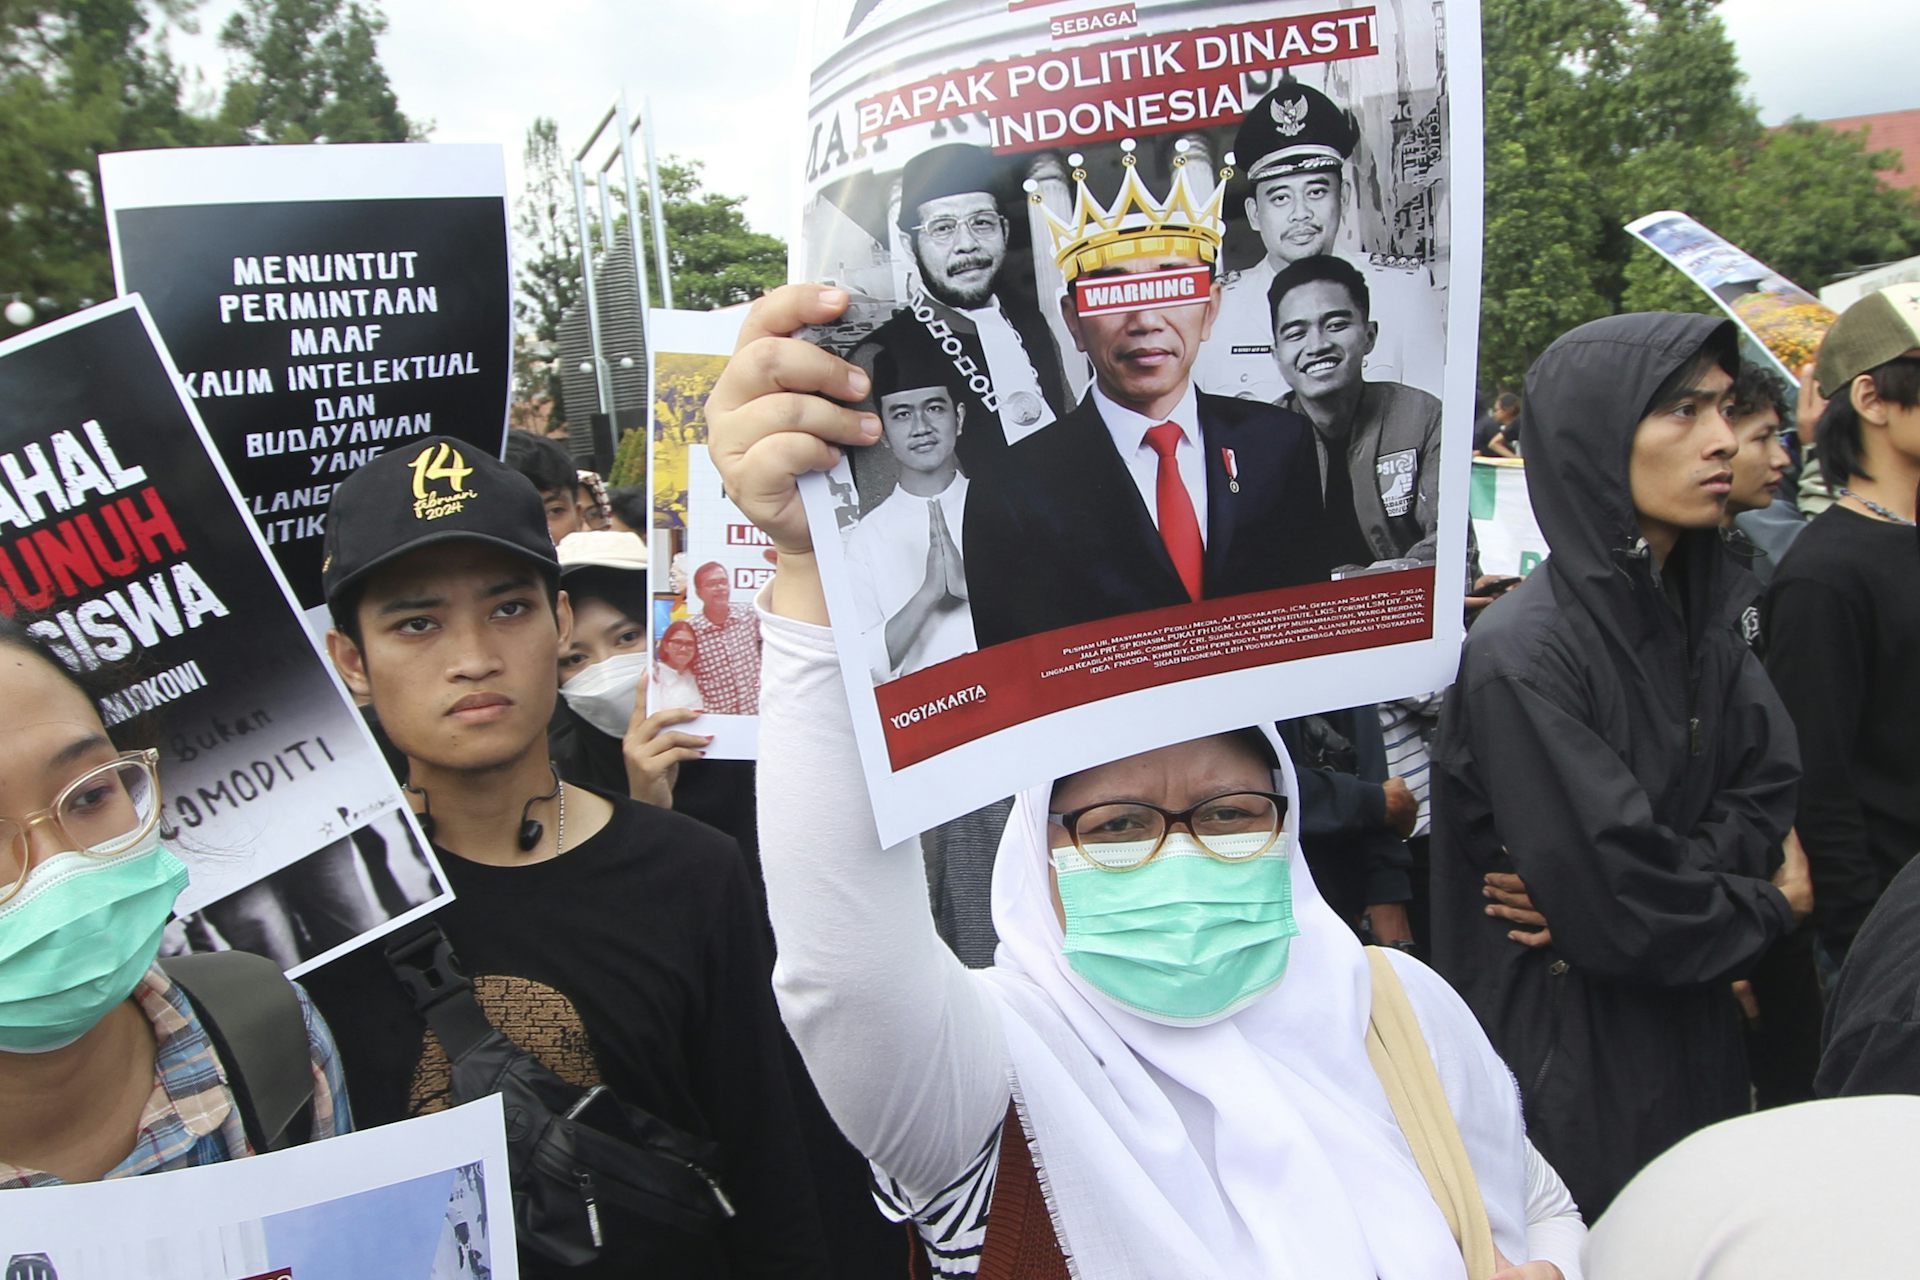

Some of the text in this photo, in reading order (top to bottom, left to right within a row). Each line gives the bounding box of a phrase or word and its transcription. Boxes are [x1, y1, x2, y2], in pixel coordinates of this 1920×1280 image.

[1051, 9, 1135, 36] SEBAGAI
[859, 71, 997, 134] BAPAK
[1007, 40, 1185, 98] POLITIK
[1195, 14, 1379, 70] DINASTI
[990, 84, 1243, 147] INDONESIA
[234, 251, 418, 286] MENUNTUT
[219, 286, 438, 323] PERMINTAAN
[1085, 276, 1195, 307] WARNING
[291, 324, 382, 356] MAAF
[288, 352, 480, 391] INTELEKTUAL
[315, 394, 375, 421] DAN
[246, 413, 431, 457] BUDAYAWAN
[407, 442, 474, 500] 14
[242, 482, 343, 515] LANG
[425, 501, 464, 520] 2024
[0, 486, 188, 618] UNUH
[737, 569, 777, 589] DE
[1080, 651, 1099, 660] JALA
[1120, 642, 1132, 650] SP
[1168, 631, 1195, 641] PUKAT
[1235, 618, 1271, 628] CAKSANA
[1338, 602, 1365, 612] FORUM
[1366, 600, 1385, 608] LSM
[1111, 630, 1163, 643] MASYARAKAT
[1164, 625, 1191, 633] PEDULI
[1310, 599, 1348, 609] GERAKAN
[1371, 592, 1389, 600] KPK
[1152, 651, 1172, 660] KHM
[1190, 645, 1209, 653] LBH
[1210, 641, 1230, 649] PERS
[1260, 631, 1283, 640] RIFKA
[1318, 622, 1348, 630] ALIANSI
[1349, 616, 1380, 626] RAKYAT
[1041, 665, 1074, 679] LINGKAR
[1075, 654, 1114, 669] KEADILAN
[1145, 642, 1180, 653] COMBINE
[1252, 624, 1277, 633] LHKP
[1357, 609, 1386, 617] WARGA
[1153, 658, 1180, 668] SIGAB
[1225, 646, 1243, 654] LBH
[1296, 632, 1334, 642] LEMBAGA
[1335, 625, 1375, 636] ADVOKASI
[1375, 618, 1424, 630] YOGYAKARTA
[890, 684, 987, 729] YOGYAKARTA
[170, 708, 272, 763] Bukan
